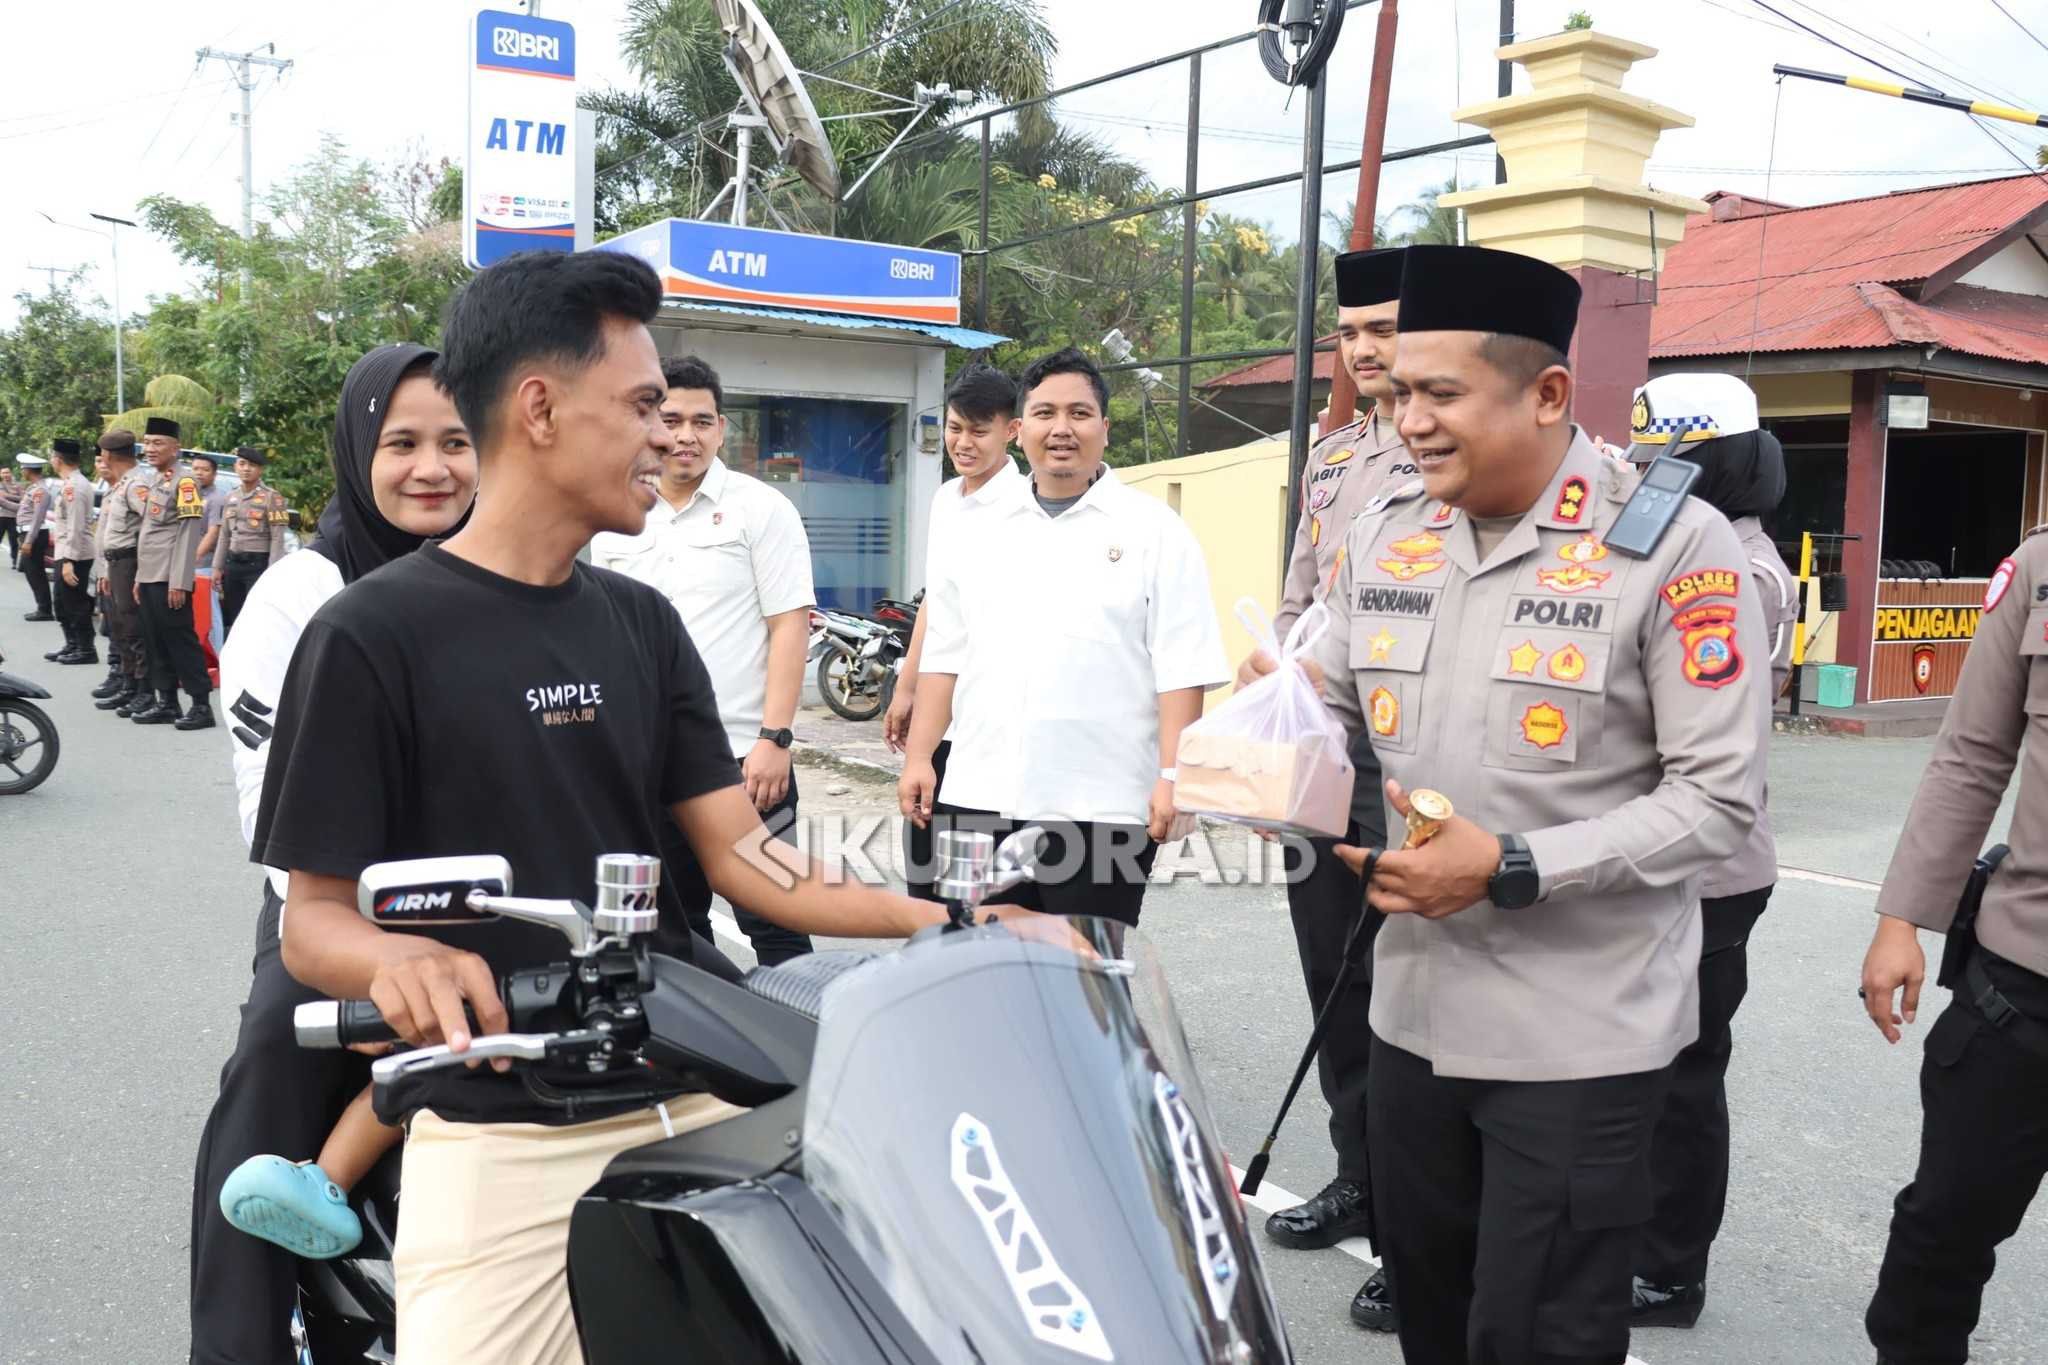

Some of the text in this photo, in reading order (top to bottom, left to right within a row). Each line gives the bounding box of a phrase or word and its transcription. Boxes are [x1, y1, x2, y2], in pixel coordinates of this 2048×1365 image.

[520, 32, 560, 61] BRI
[486, 117, 566, 156] ATM
[708, 249, 767, 277] ATM
[908, 262, 934, 281] BRI
[1311, 466, 1347, 484] AGIT
[1389, 463, 1421, 475] POL
[1666, 571, 1735, 599] POLRES
[1357, 587, 1434, 616] HENDRAWAN
[1514, 599, 1603, 629] POLRI
[1875, 608, 1980, 640] PENJAGAAN
[526, 683, 604, 712] SIMPLE
